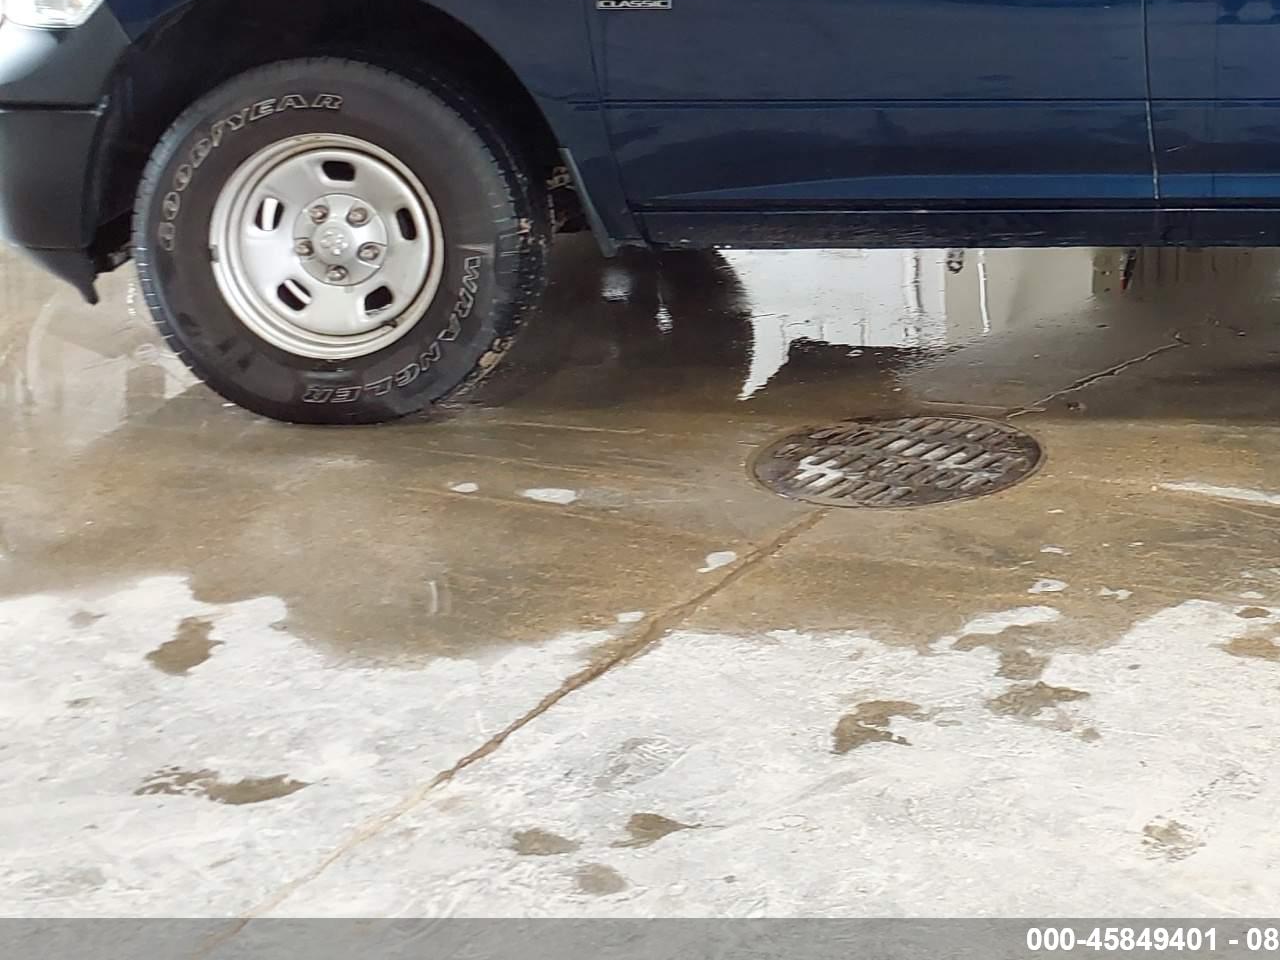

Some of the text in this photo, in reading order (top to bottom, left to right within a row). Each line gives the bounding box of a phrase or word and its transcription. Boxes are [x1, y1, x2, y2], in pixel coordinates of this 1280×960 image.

[599, 0, 667, 8] CLASSIC
[158, 94, 344, 252] GOODYEAR
[302, 255, 485, 404] WRANGLER
